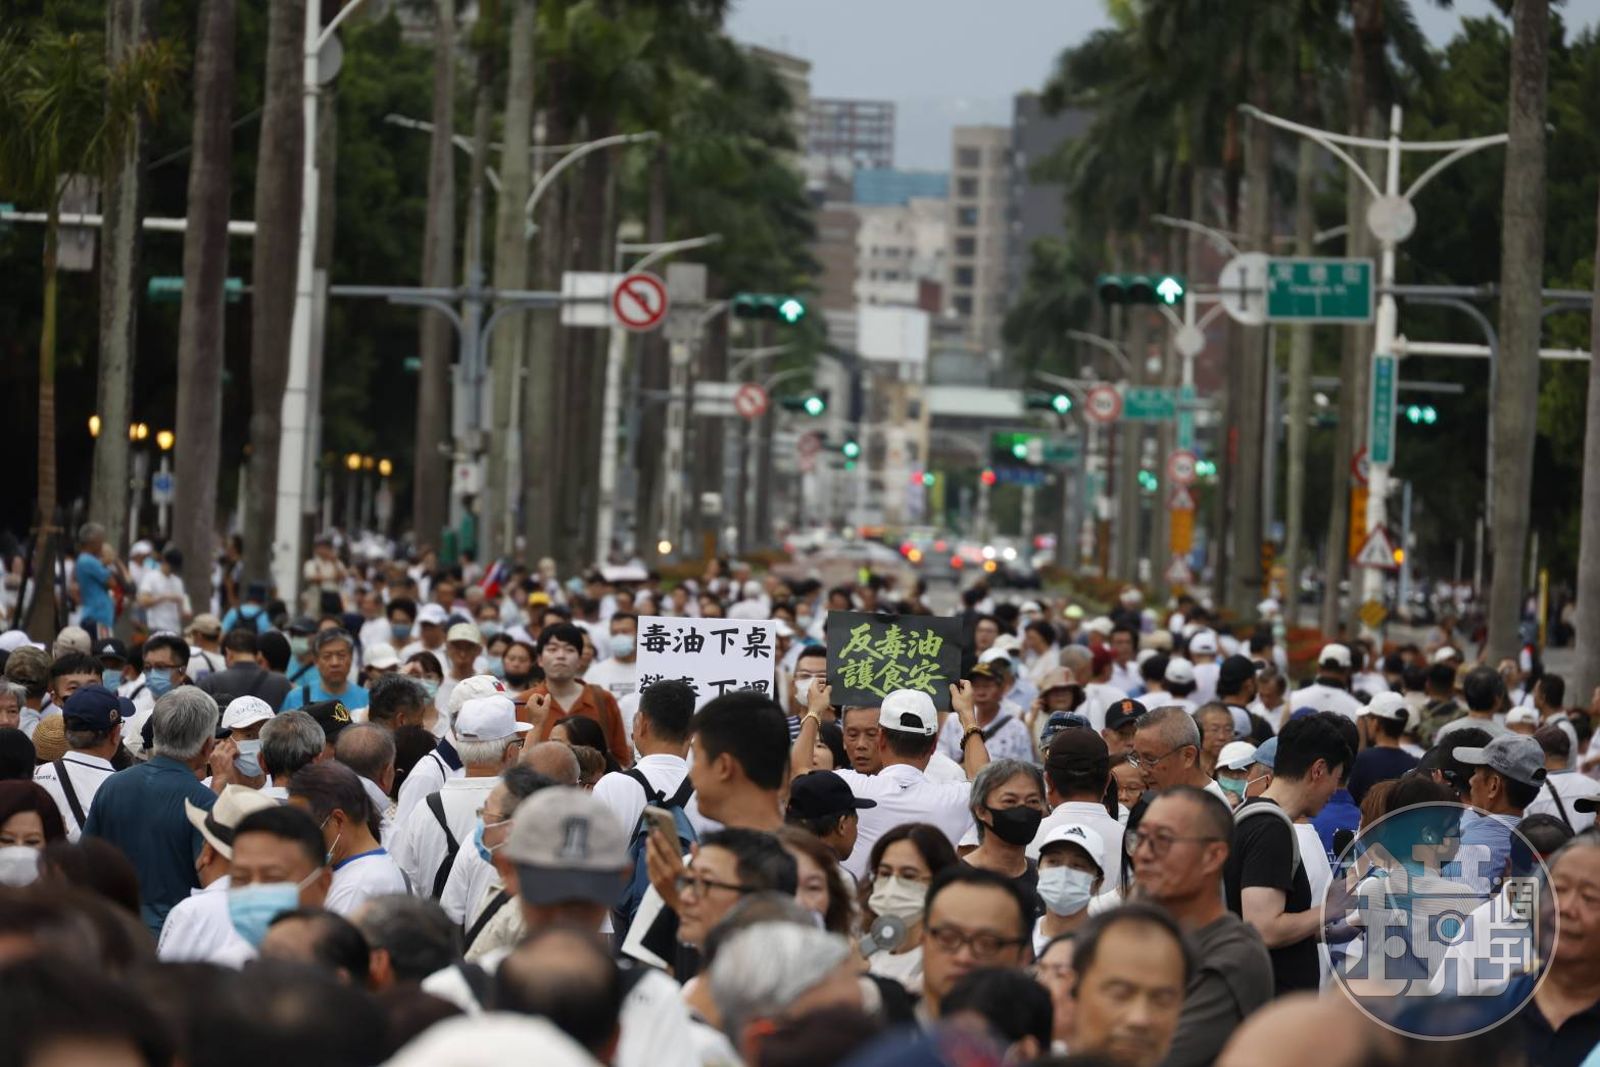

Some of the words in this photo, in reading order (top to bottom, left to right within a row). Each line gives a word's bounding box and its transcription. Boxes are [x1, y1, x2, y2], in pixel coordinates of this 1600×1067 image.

[640, 623, 772, 659] 毒油下桌
[838, 622, 944, 660] 反毒油
[836, 658, 948, 698] 護食安
